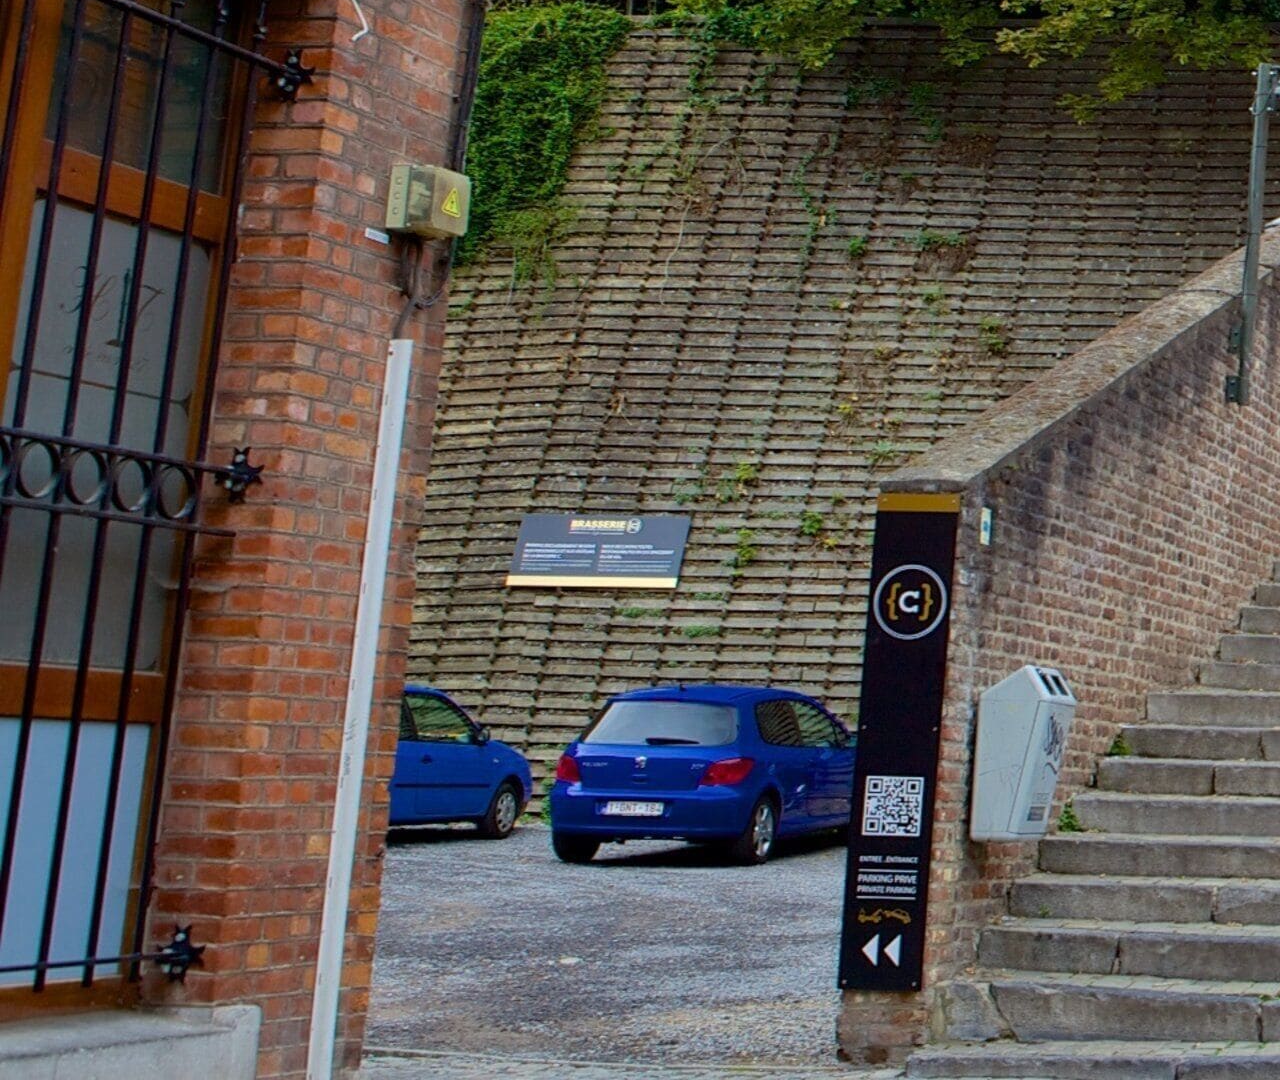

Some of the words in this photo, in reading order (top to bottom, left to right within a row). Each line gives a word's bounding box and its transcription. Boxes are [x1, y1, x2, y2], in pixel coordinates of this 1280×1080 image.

[569, 519, 627, 530] BRASSERIE
[857, 873, 893, 883] PARKING
[857, 885, 884, 894] PRIVATE
[886, 886, 916, 894] PARKING
